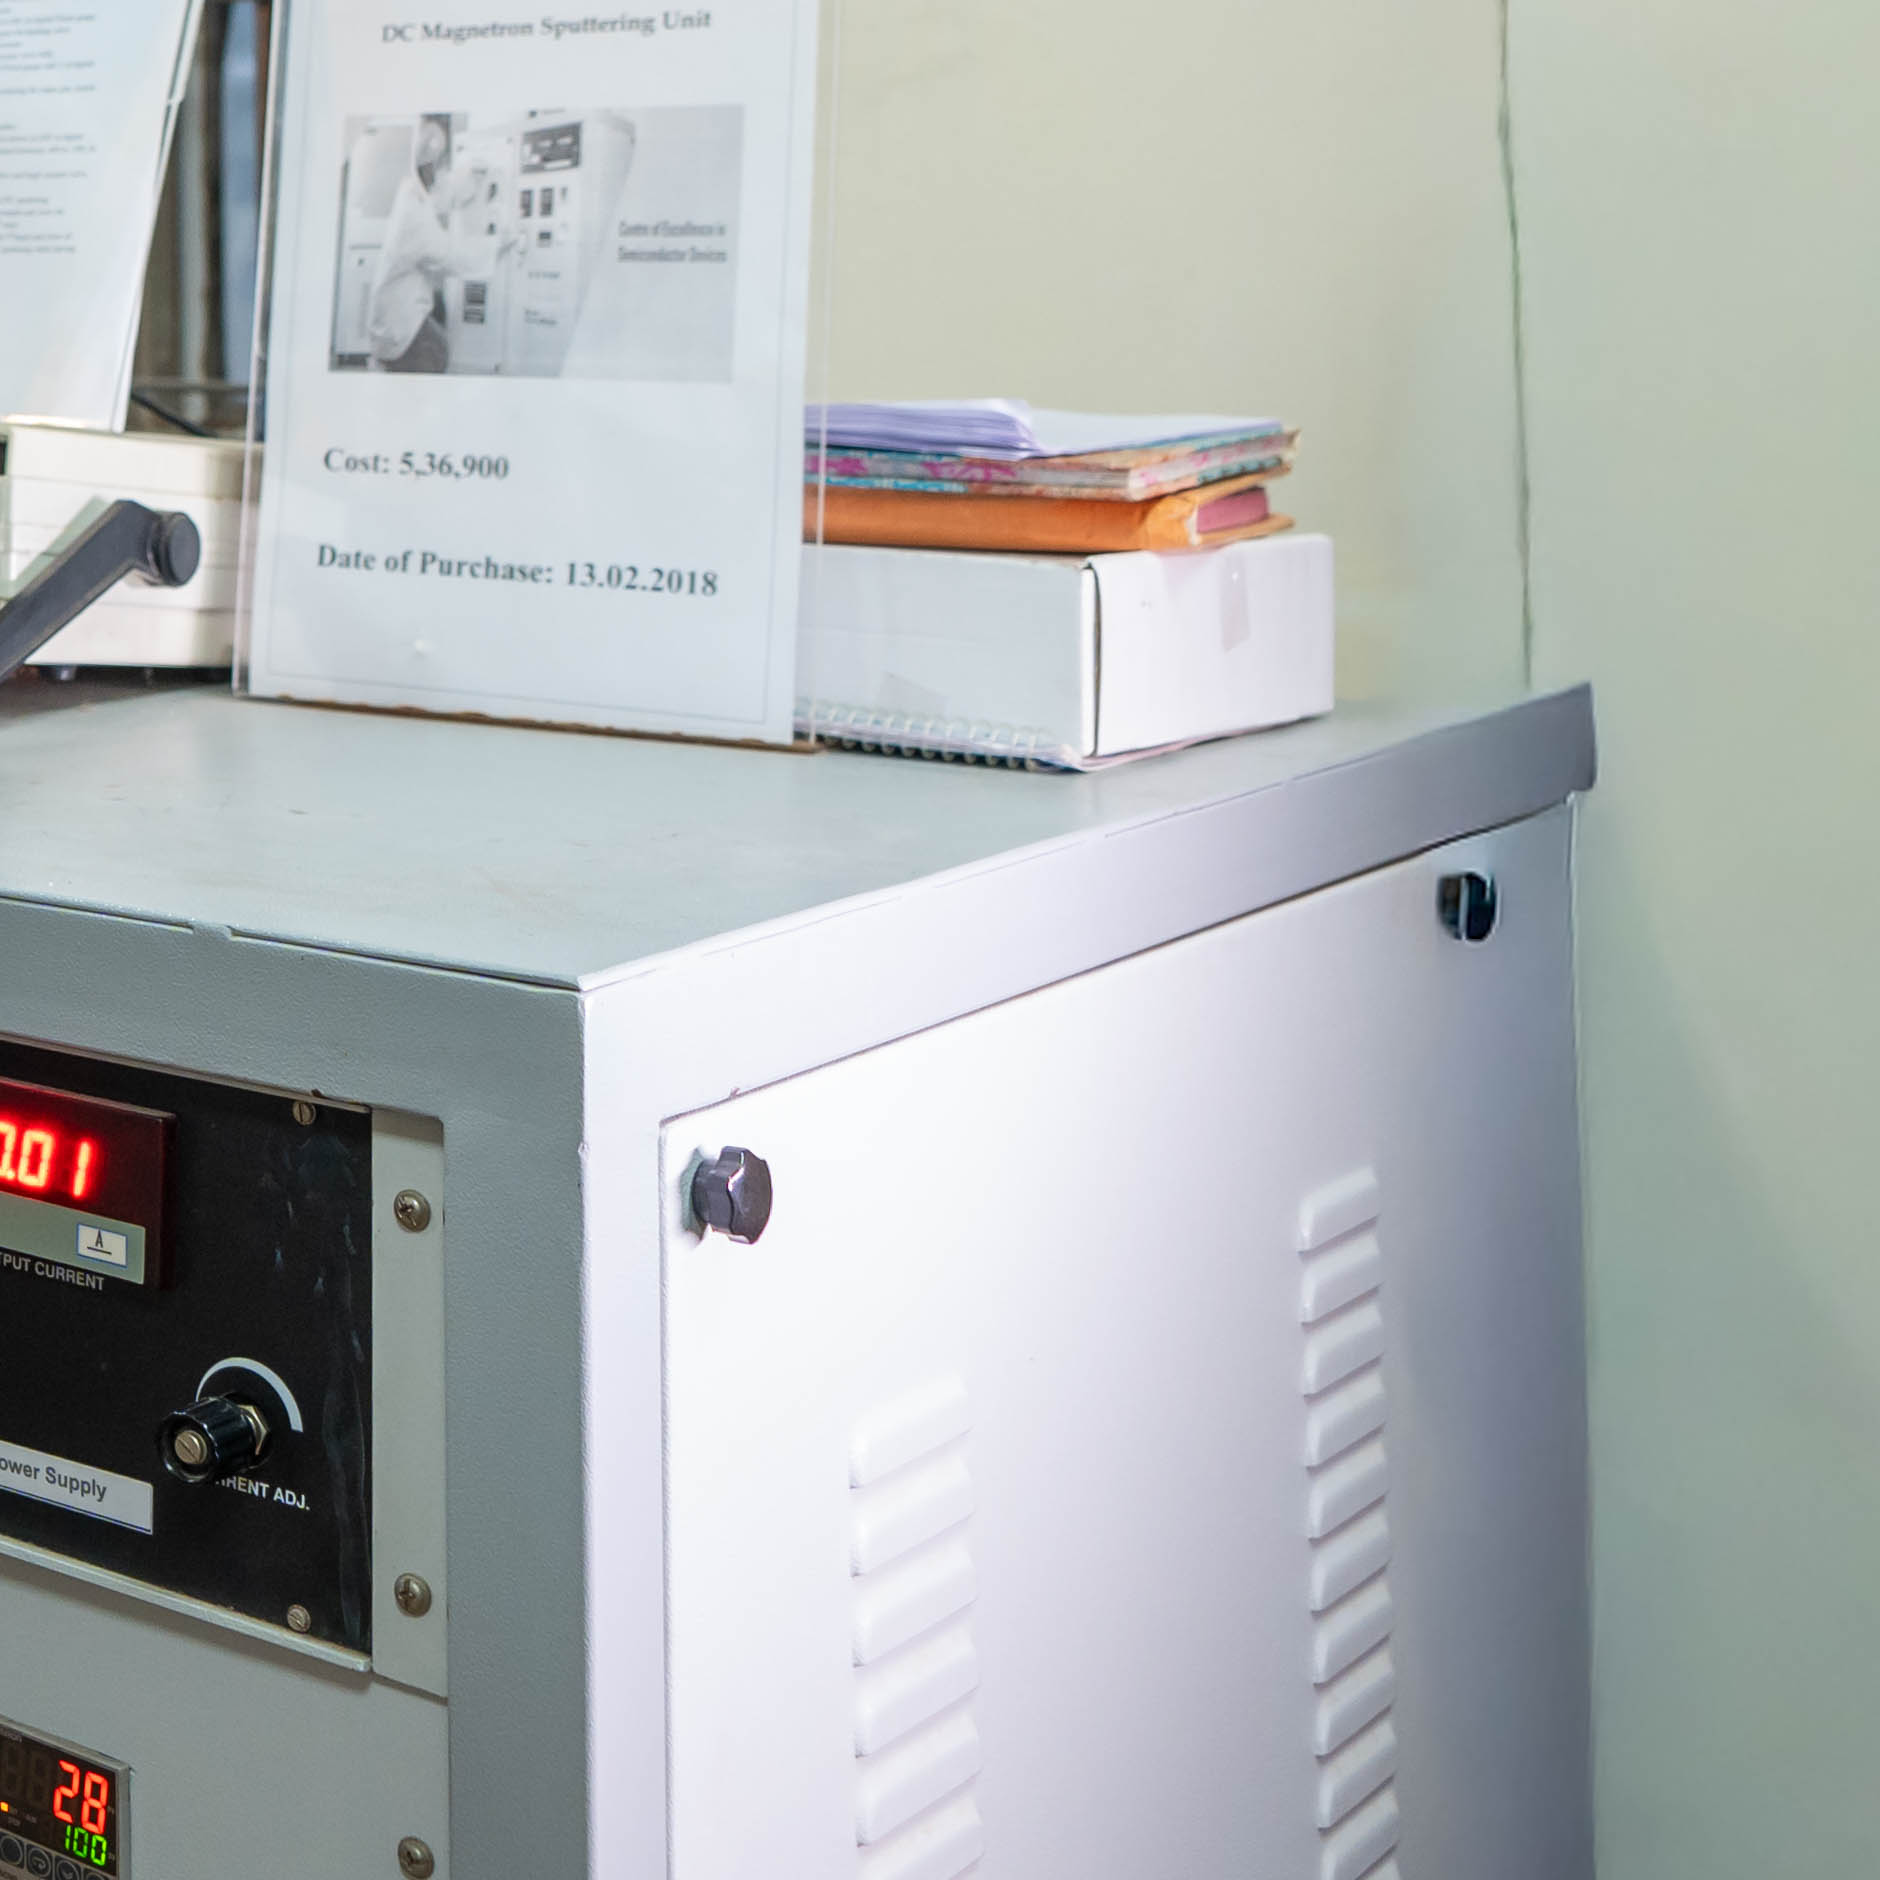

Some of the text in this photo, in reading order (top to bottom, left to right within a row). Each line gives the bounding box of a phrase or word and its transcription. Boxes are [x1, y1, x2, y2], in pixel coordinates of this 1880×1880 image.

[382, 10, 712, 45] DC Magnetron Sputtering Unit
[323, 447, 510, 482] Cost: 5,36,900
[317, 543, 719, 598] Date of Purchase: 13.02.2018
[35, 1261, 105, 1291] CURRENT
[44, 1466, 109, 1503] Supply
[273, 1486, 312, 1511] ADJ.
[53, 1759, 109, 1835] 28
[64, 1824, 108, 1867] 100
